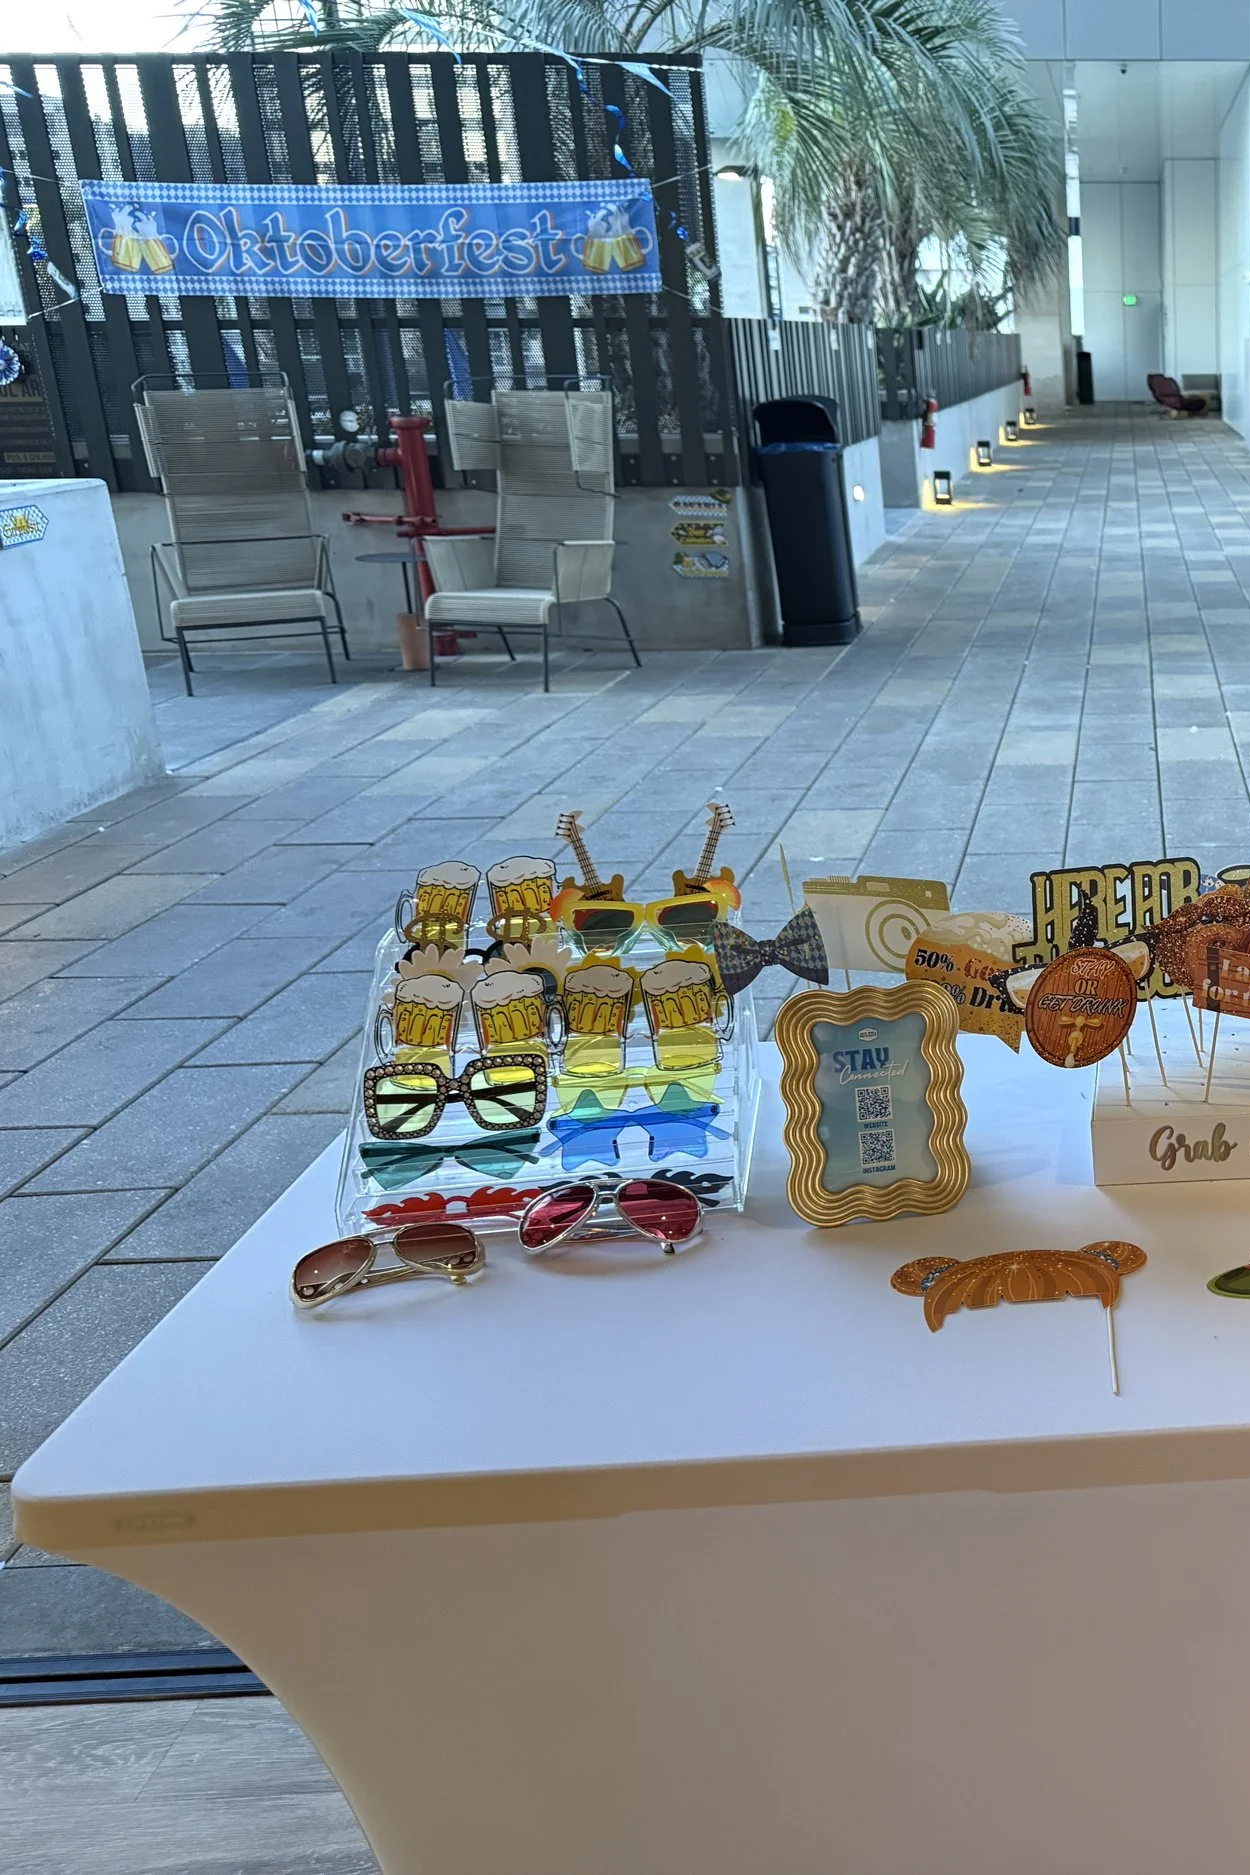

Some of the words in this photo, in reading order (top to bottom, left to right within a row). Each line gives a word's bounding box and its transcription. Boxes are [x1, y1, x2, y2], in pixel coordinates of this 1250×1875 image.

[184, 206, 566, 275] Oktoberfest
[915, 949, 954, 973] 50%
[1071, 957, 1115, 979] STAY
[1221, 959, 1230, 977] I
[1074, 979, 1098, 996] OR
[1201, 978, 1238, 1003] for
[1038, 993, 1074, 1012] GET
[1070, 996, 1129, 1018] DRUNK
[832, 1046, 890, 1073] STAY
[839, 1059, 909, 1085] Connected
[863, 1120, 889, 1129] WEBSITE
[1149, 1122, 1238, 1171] Grab
[862, 1164, 896, 1174] INSTAGRAM
